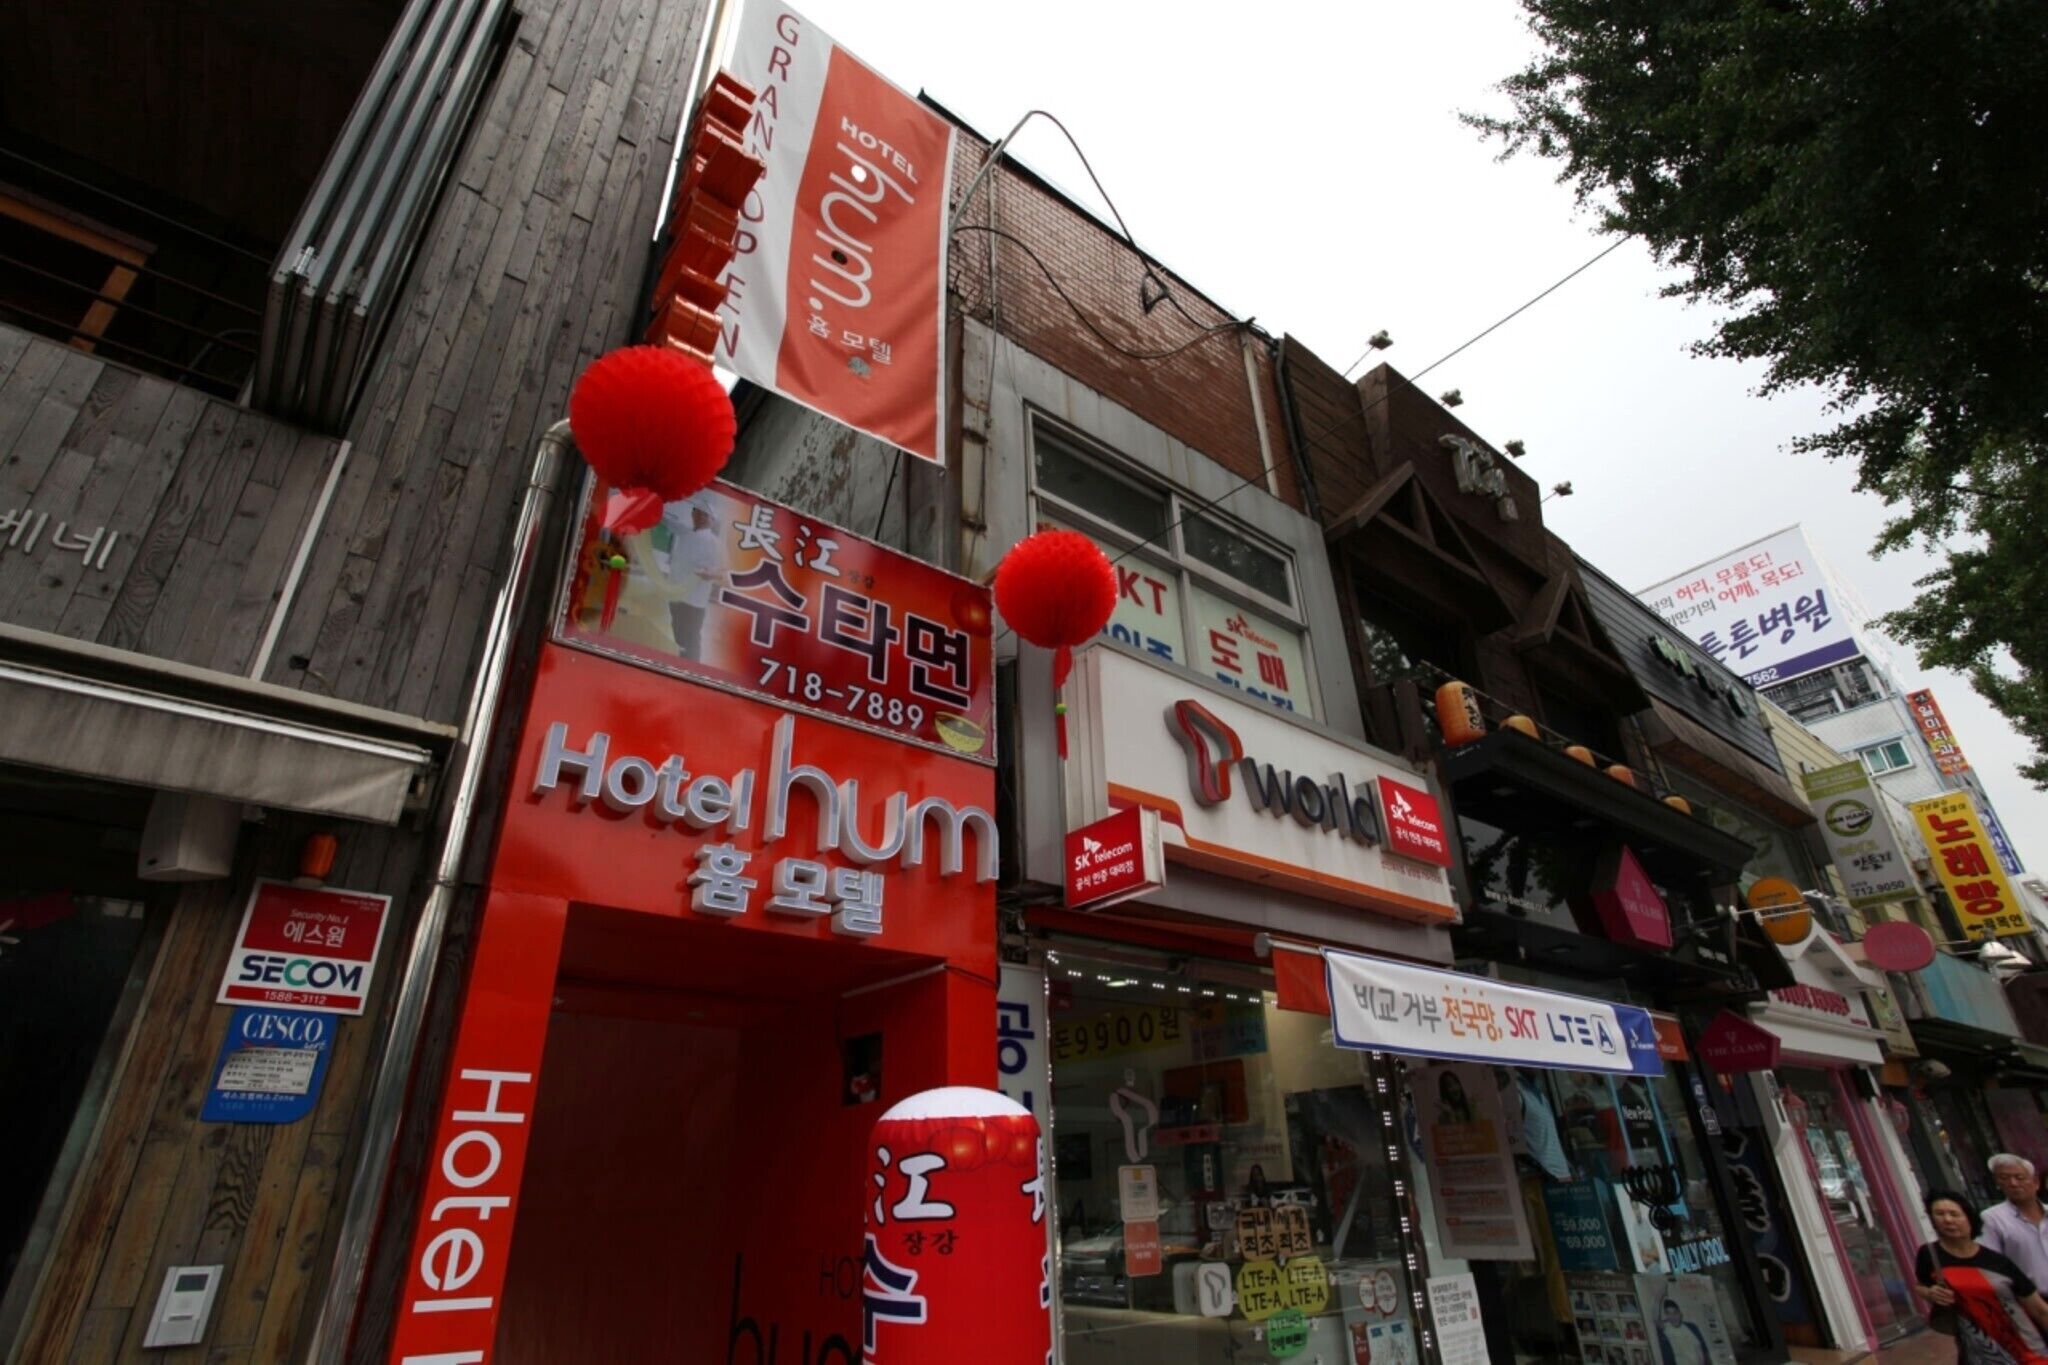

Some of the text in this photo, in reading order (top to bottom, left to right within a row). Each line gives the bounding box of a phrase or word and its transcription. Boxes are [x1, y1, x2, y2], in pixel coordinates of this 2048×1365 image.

[752, 13, 800, 181] GRAN
[840, 116, 918, 184] HOTEL
[719, 188, 766, 359] OPEN
[840, 330, 892, 365] 모텔
[733, 502, 841, 579] 長江
[1715, 552, 1774, 586] 무릎도!
[1761, 560, 1804, 589] 목도!
[717, 557, 972, 711] 수타면
[758, 657, 925, 732] 718-7889
[532, 713, 1001, 886] Hotel hum
[1239, 756, 1382, 849] world
[1390, 803, 1439, 833] SK telecom
[1074, 841, 1134, 872] SK telecom
[1926, 812, 2005, 917] 노래방
[687, 842, 886, 937] 홈 모텔
[1075, 874, 1092, 892] 공식
[1108, 859, 1135, 877] 대리점
[289, 908, 327, 924] Security
[283, 919, 347, 949] 에스원
[238, 954, 364, 992] SECOM
[264, 990, 328, 1006] 1588-3112
[1353, 982, 1399, 1023] 비교
[1402, 991, 1442, 1035] 거부
[1504, 1005, 1539, 1042] SKT
[242, 1012, 324, 1042] CESCO
[412, 1068, 533, 1314] Hotel
[873, 1146, 955, 1226] 江
[903, 1230, 960, 1257] 장강
[1241, 1268, 1280, 1289] LTE-A
[1287, 1264, 1322, 1285] LTE-A
[1243, 1290, 1282, 1313] LTE-A
[1289, 1285, 1326, 1307] LTE-A
